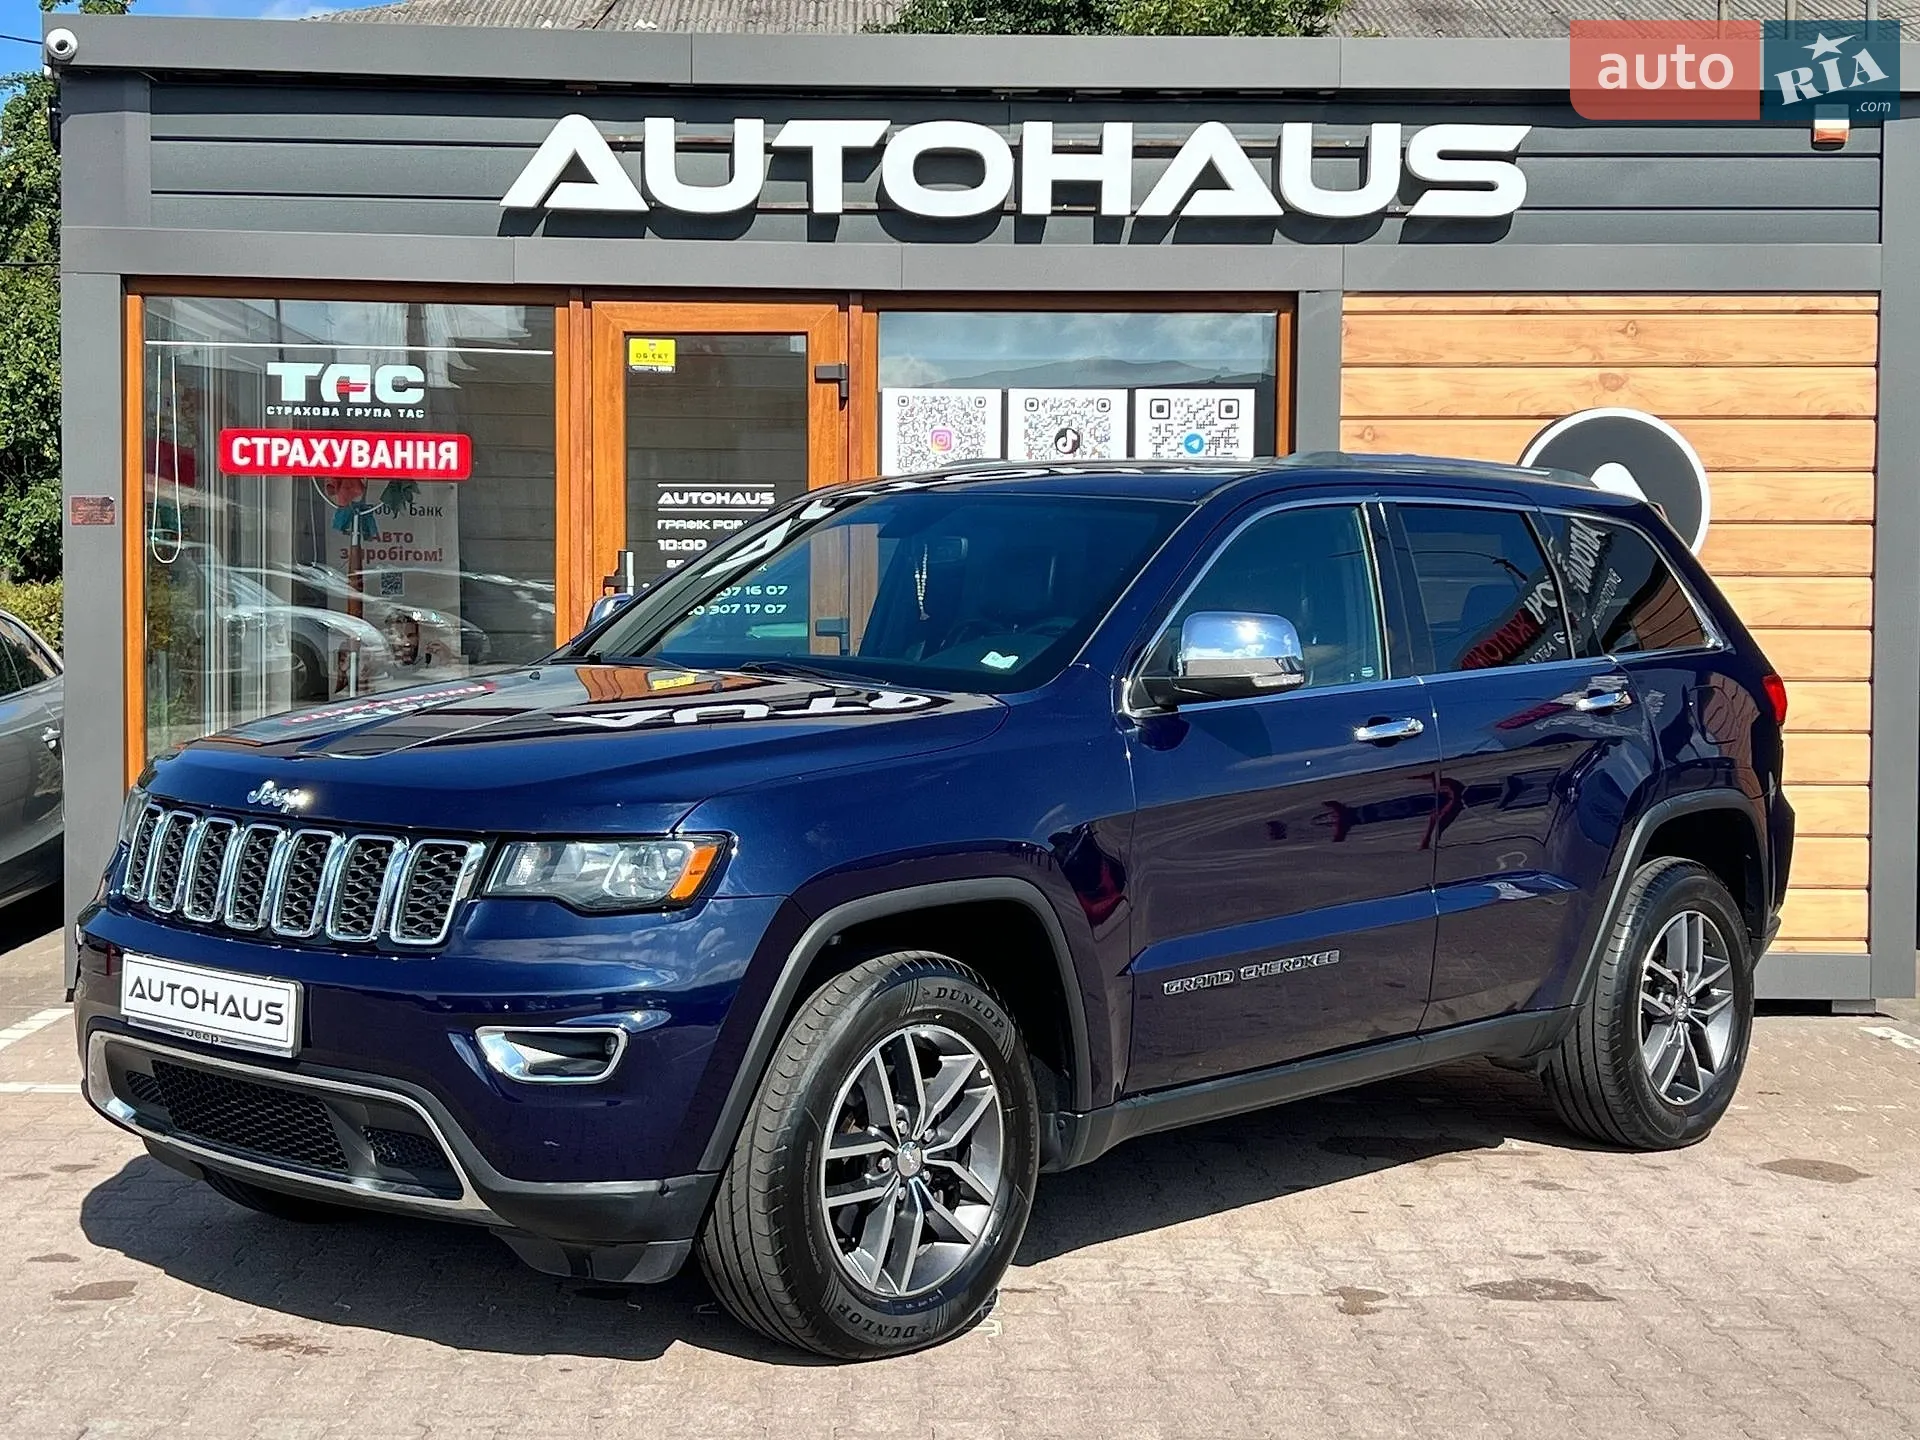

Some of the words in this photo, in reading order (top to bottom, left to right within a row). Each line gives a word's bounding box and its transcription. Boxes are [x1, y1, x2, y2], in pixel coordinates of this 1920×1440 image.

[499, 113, 1532, 217] AUTOHAUS
[266, 406, 340, 417] СТРАХОВА
[346, 408, 391, 418] ГРУПА
[398, 409, 425, 419] ТАС
[232, 437, 458, 471] СТРАХУВАННЯ
[657, 492, 775, 505] AUTOHAUS
[409, 504, 443, 517] Банк
[657, 519, 710, 530] ГРАФІК
[657, 539, 708, 551] 10:00
[716, 586, 741, 597] 07
[745, 586, 762, 596] 16
[766, 586, 788, 596] 07
[709, 604, 740, 615] 307
[744, 604, 760, 614] 17
[764, 604, 787, 614] 07
[1163, 969, 1235, 996] GRAND
[1239, 949, 1341, 981] CHEROKEE
[128, 975, 285, 1026] AUTOHAUS
[935, 987, 1004, 1028] DUNLOP
[186, 1029, 220, 1045] Jeep
[837, 1303, 917, 1338] DUNLOP
